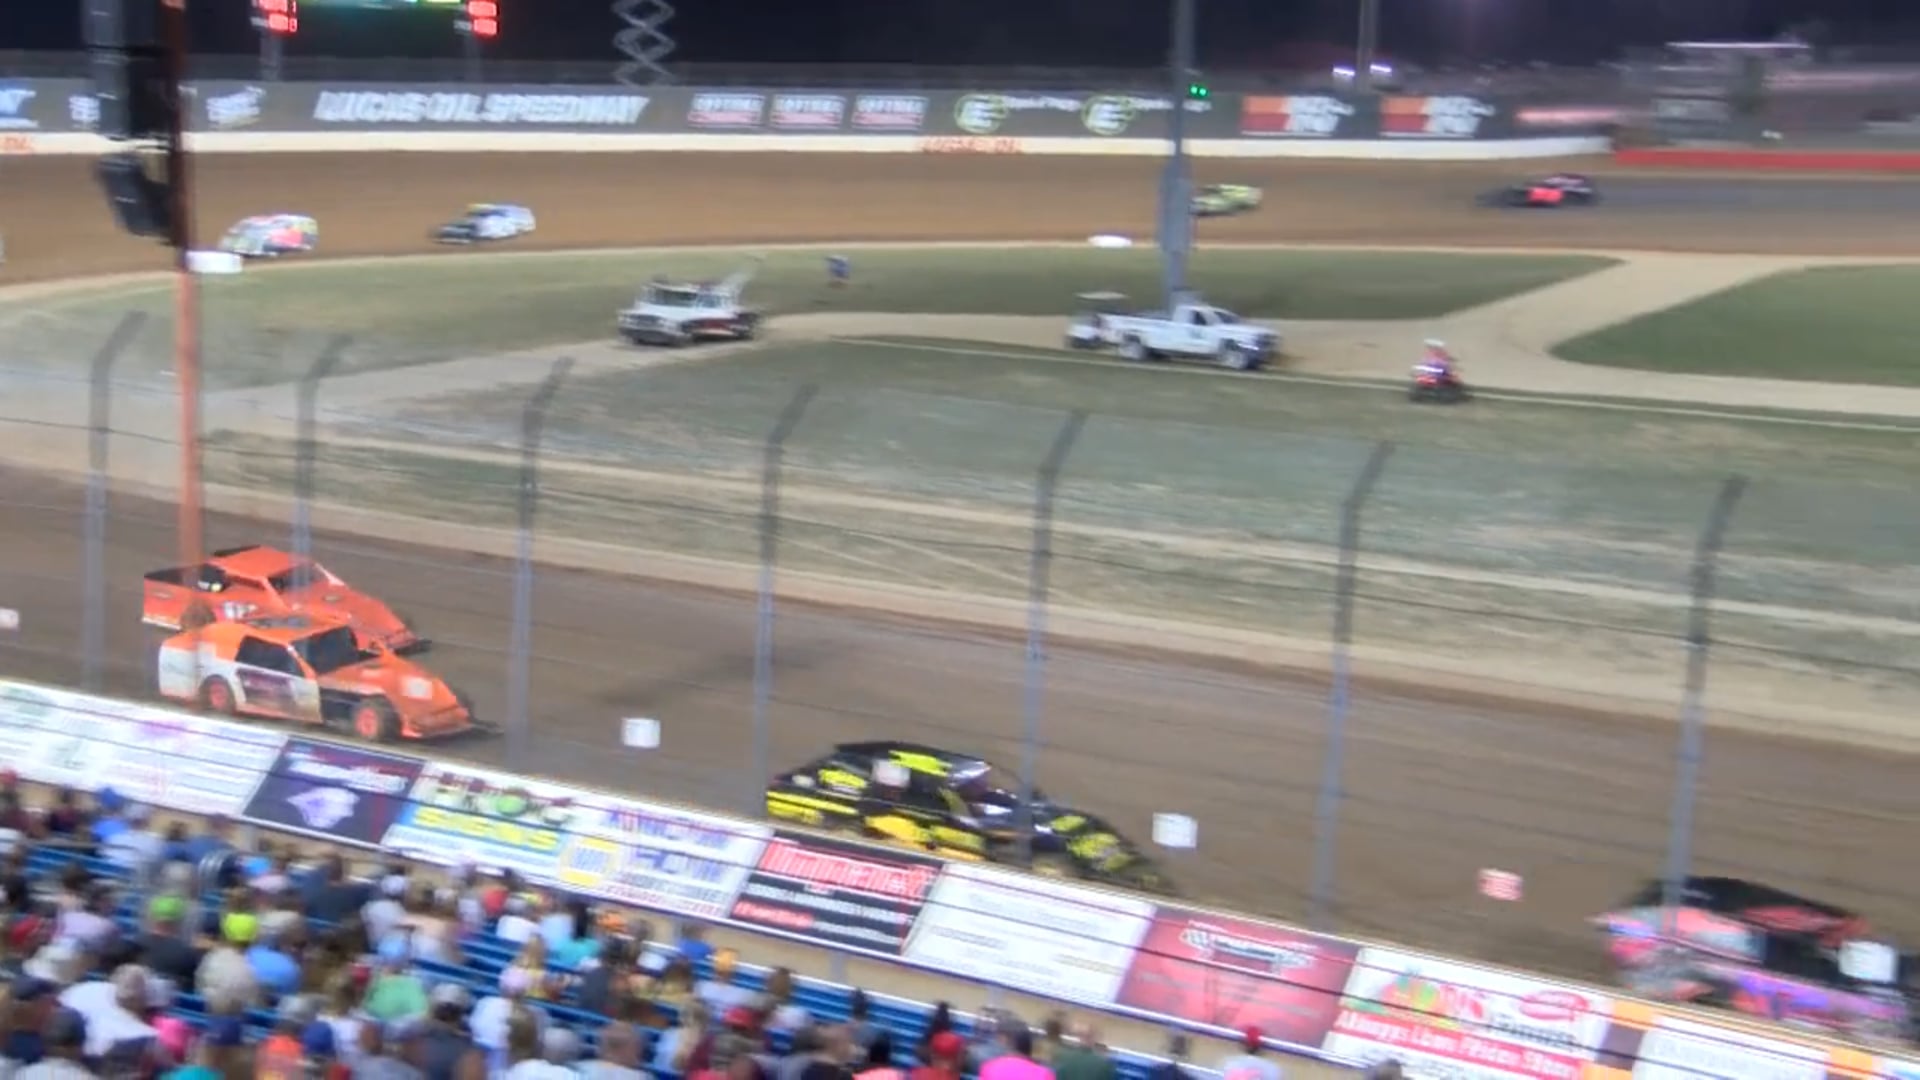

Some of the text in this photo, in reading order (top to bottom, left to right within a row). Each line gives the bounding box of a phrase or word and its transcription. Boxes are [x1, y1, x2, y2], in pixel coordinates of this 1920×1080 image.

[313, 91, 650, 124] LUCAS OIL SPEEDWAY
